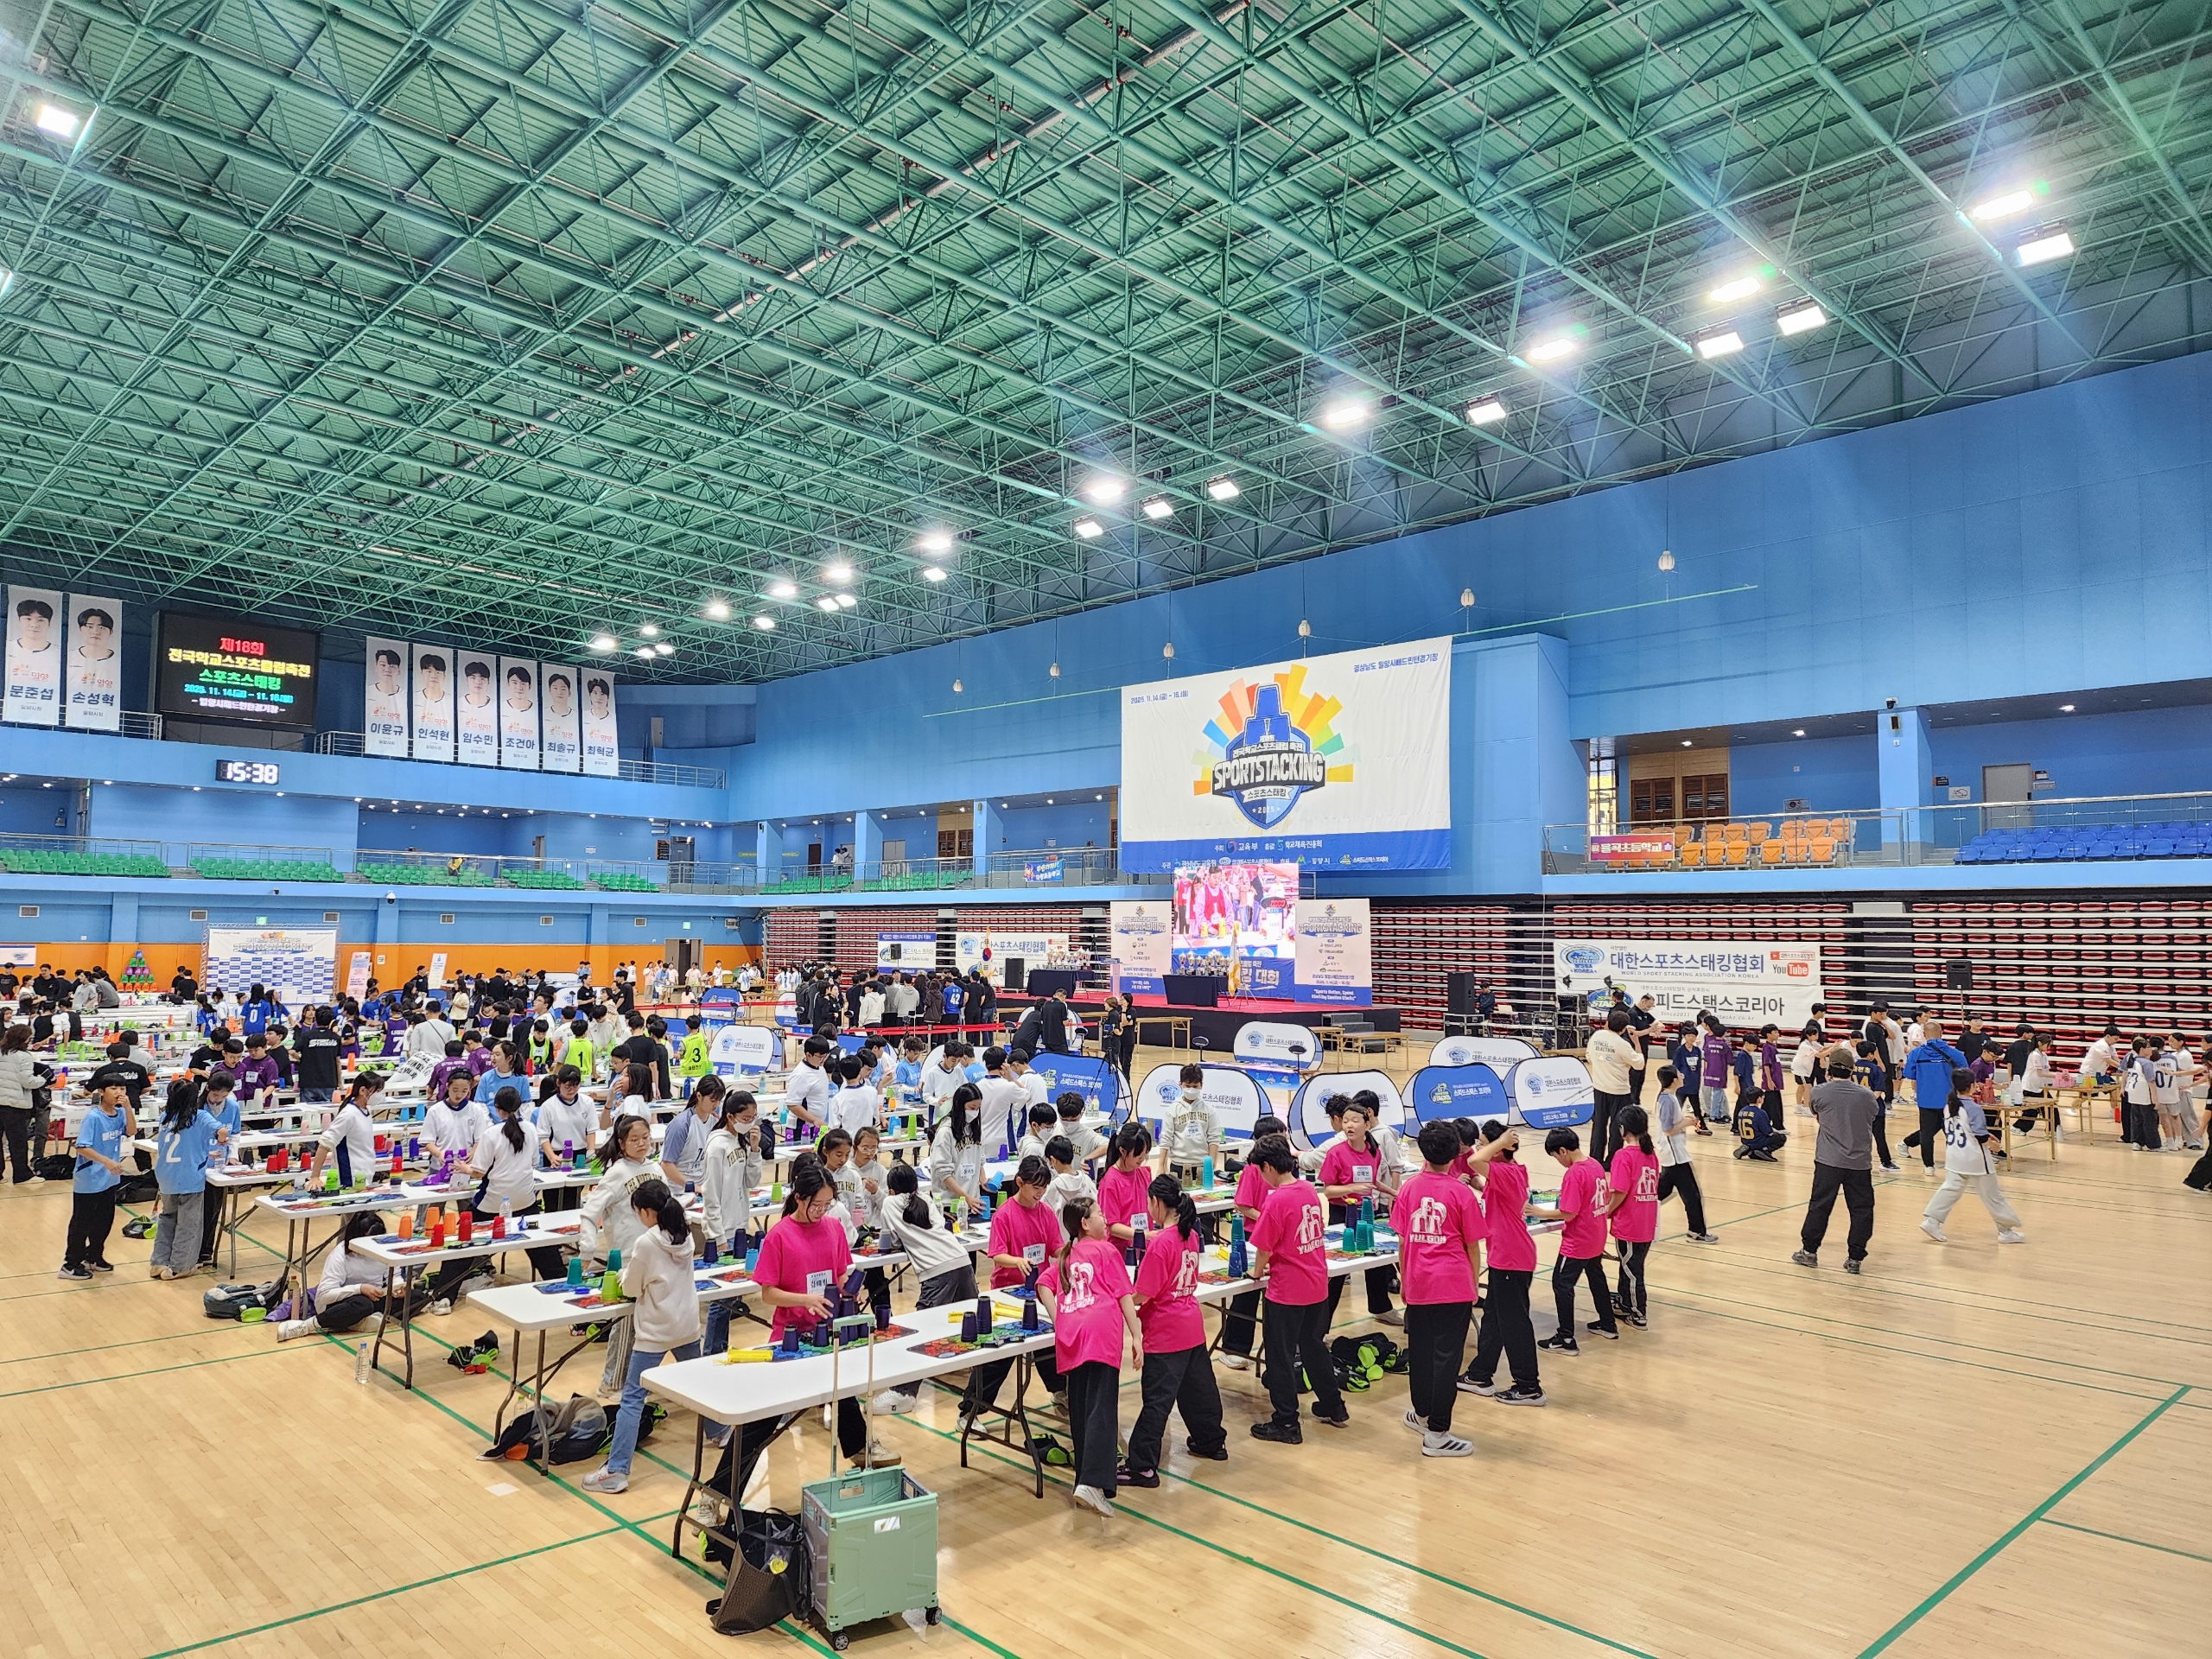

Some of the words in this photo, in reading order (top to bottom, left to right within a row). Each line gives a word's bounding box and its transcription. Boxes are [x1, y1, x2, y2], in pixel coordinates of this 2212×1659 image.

[219, 637, 264, 656] 제18회
[1353, 662, 1377, 673] 경상남도
[97, 678, 114, 689] 밀양
[199, 669, 282, 690] 스포츠스태킹
[10, 684, 54, 701] 문준섭
[72, 691, 115, 706] 손성혁
[370, 722, 404, 736] 이윤규
[418, 728, 449, 741] 인석현
[462, 732, 493, 747] 임수민
[505, 737, 536, 750] 조건아
[547, 741, 576, 754] 최솔규
[587, 745, 614, 757] 최혁균
[226, 761, 278, 785] 15:38
[1213, 753, 1324, 791] SPORTSTACKING
[1247, 787, 1287, 799] 스포츠스태킹
[1238, 842, 1258, 851] 교육부
[1299, 922, 1363, 934] SPORTSTACKING
[1610, 951, 1764, 973] 대한스포츠스태킹협회
[1255, 969, 1280, 985] 대회
[950, 994, 961, 1005] 42
[250, 1009, 258, 1023] 0
[393, 1037, 404, 1052] 7
[578, 1051, 583, 1067] 1
[692, 1047, 702, 1063] 3
[2155, 1070, 2173, 1089] 07
[1199, 1093, 1243, 1106] 포츠스태킹협회
[1738, 1118, 1755, 1140] 16
[164, 1133, 181, 1163] 2
[624, 1179, 638, 1195] THE
[845, 1181, 855, 1192] FACE
